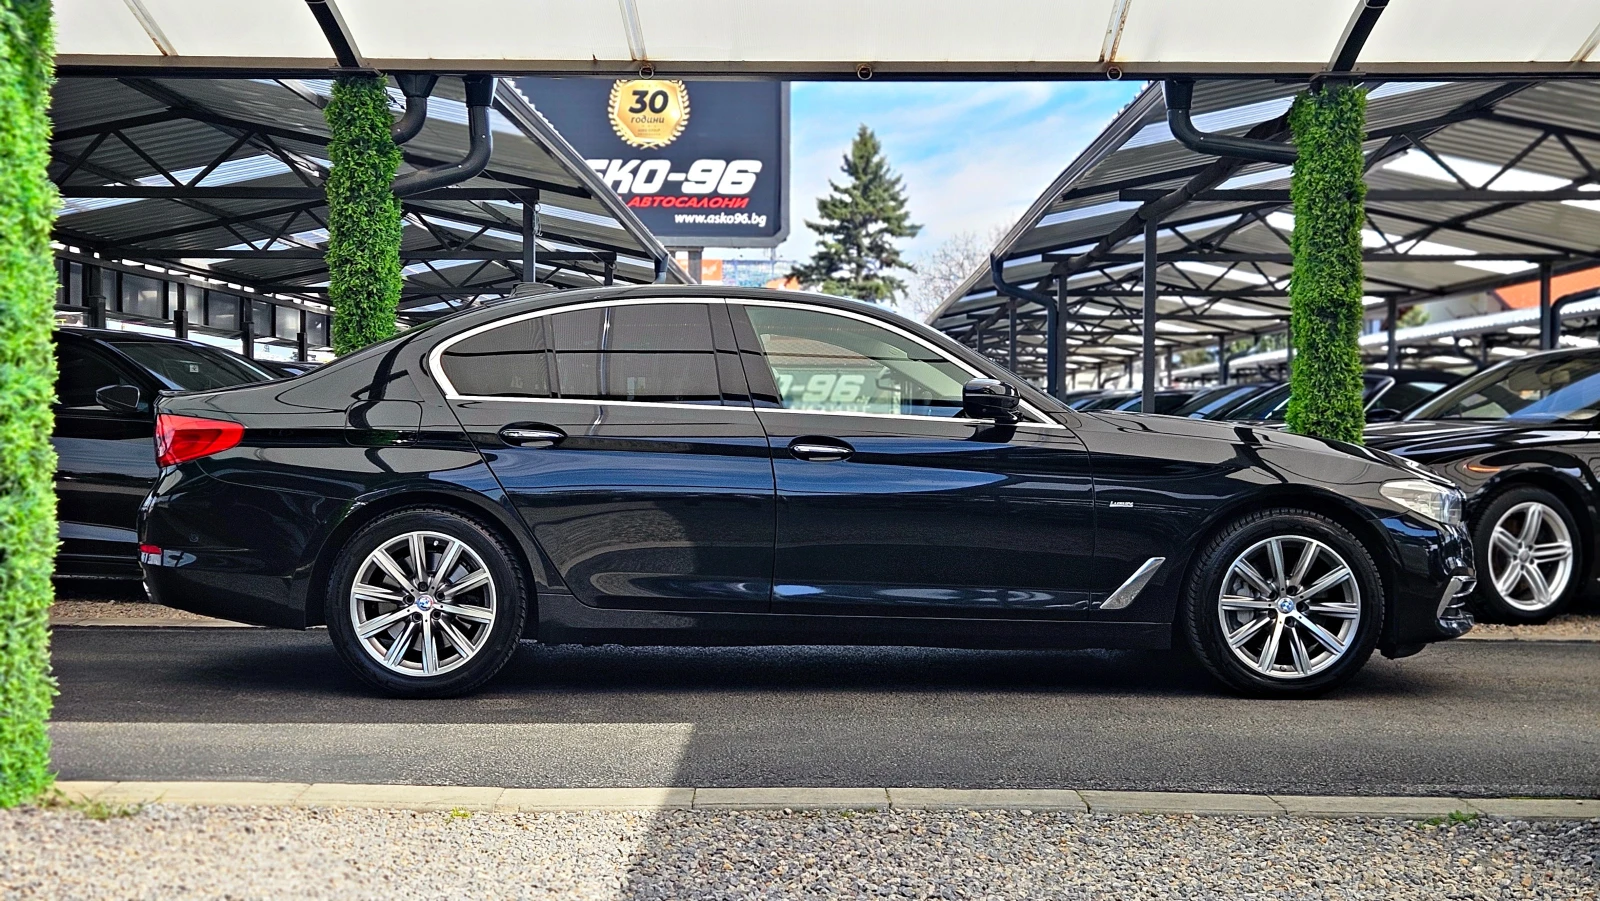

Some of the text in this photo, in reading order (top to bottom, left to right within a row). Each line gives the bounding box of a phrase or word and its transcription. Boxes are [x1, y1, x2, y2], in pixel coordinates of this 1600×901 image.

[628, 90, 669, 114] 30
[630, 115, 665, 124] години
[627, 196, 749, 209] АВТОСАЛОНИ
[674, 212, 767, 227] www.asko96.bg
